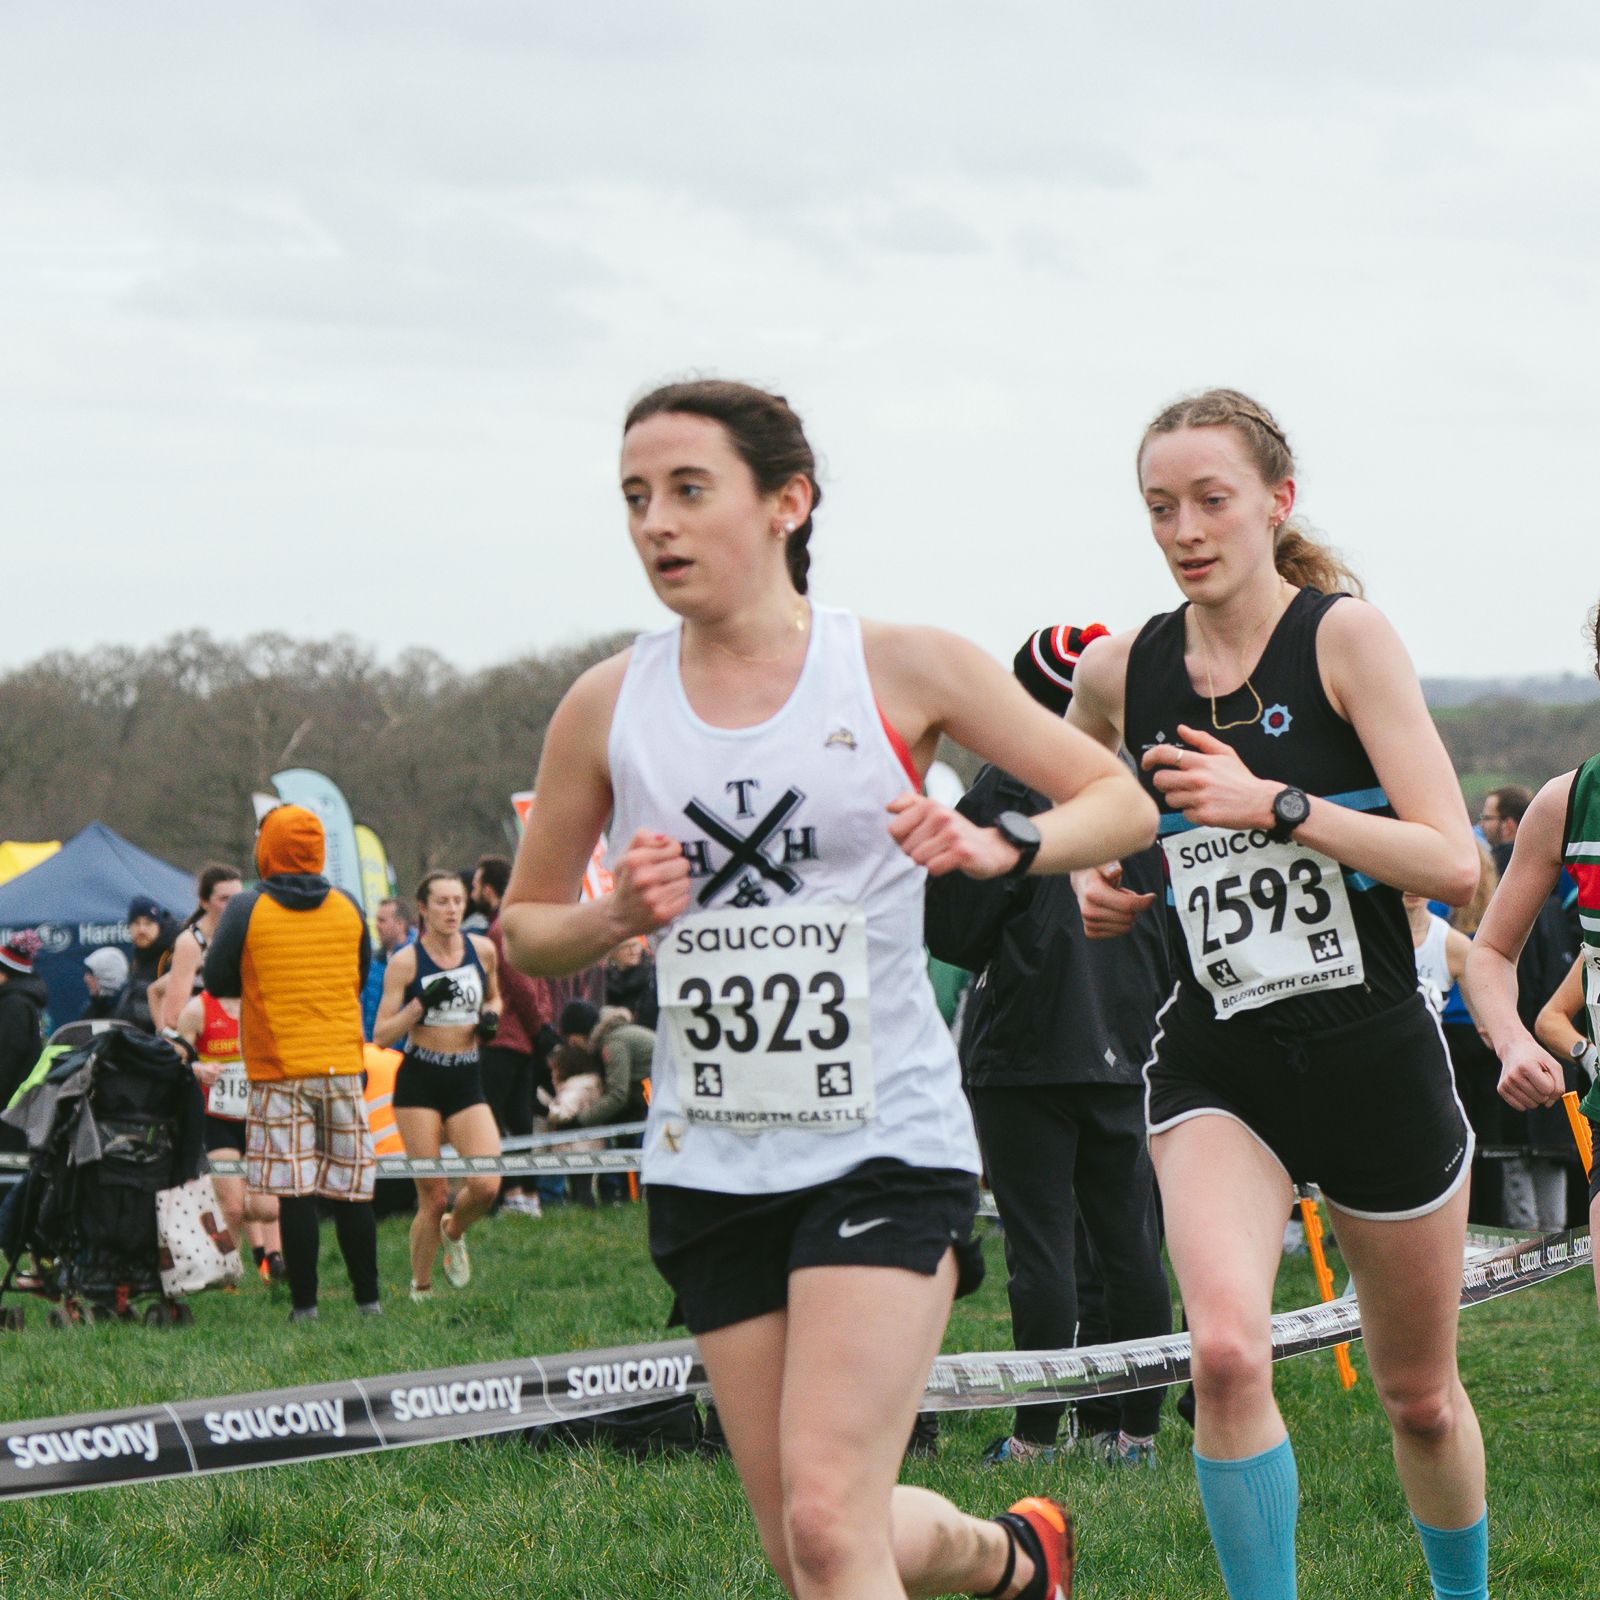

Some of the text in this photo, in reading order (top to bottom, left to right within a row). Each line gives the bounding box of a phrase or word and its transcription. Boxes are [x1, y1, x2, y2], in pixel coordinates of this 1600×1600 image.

[1180, 828, 1306, 869] sauco
[1188, 858, 1332, 956] 2593
[676, 923, 847, 954] saucony
[1301, 965, 1356, 986] CASTLE
[679, 971, 850, 1053] 3323
[215, 1079, 248, 1099] 318
[686, 1107, 866, 1124] BOLESWORTH CASTLE
[7, 1355, 694, 1468] saucony saucony saucony saucony
